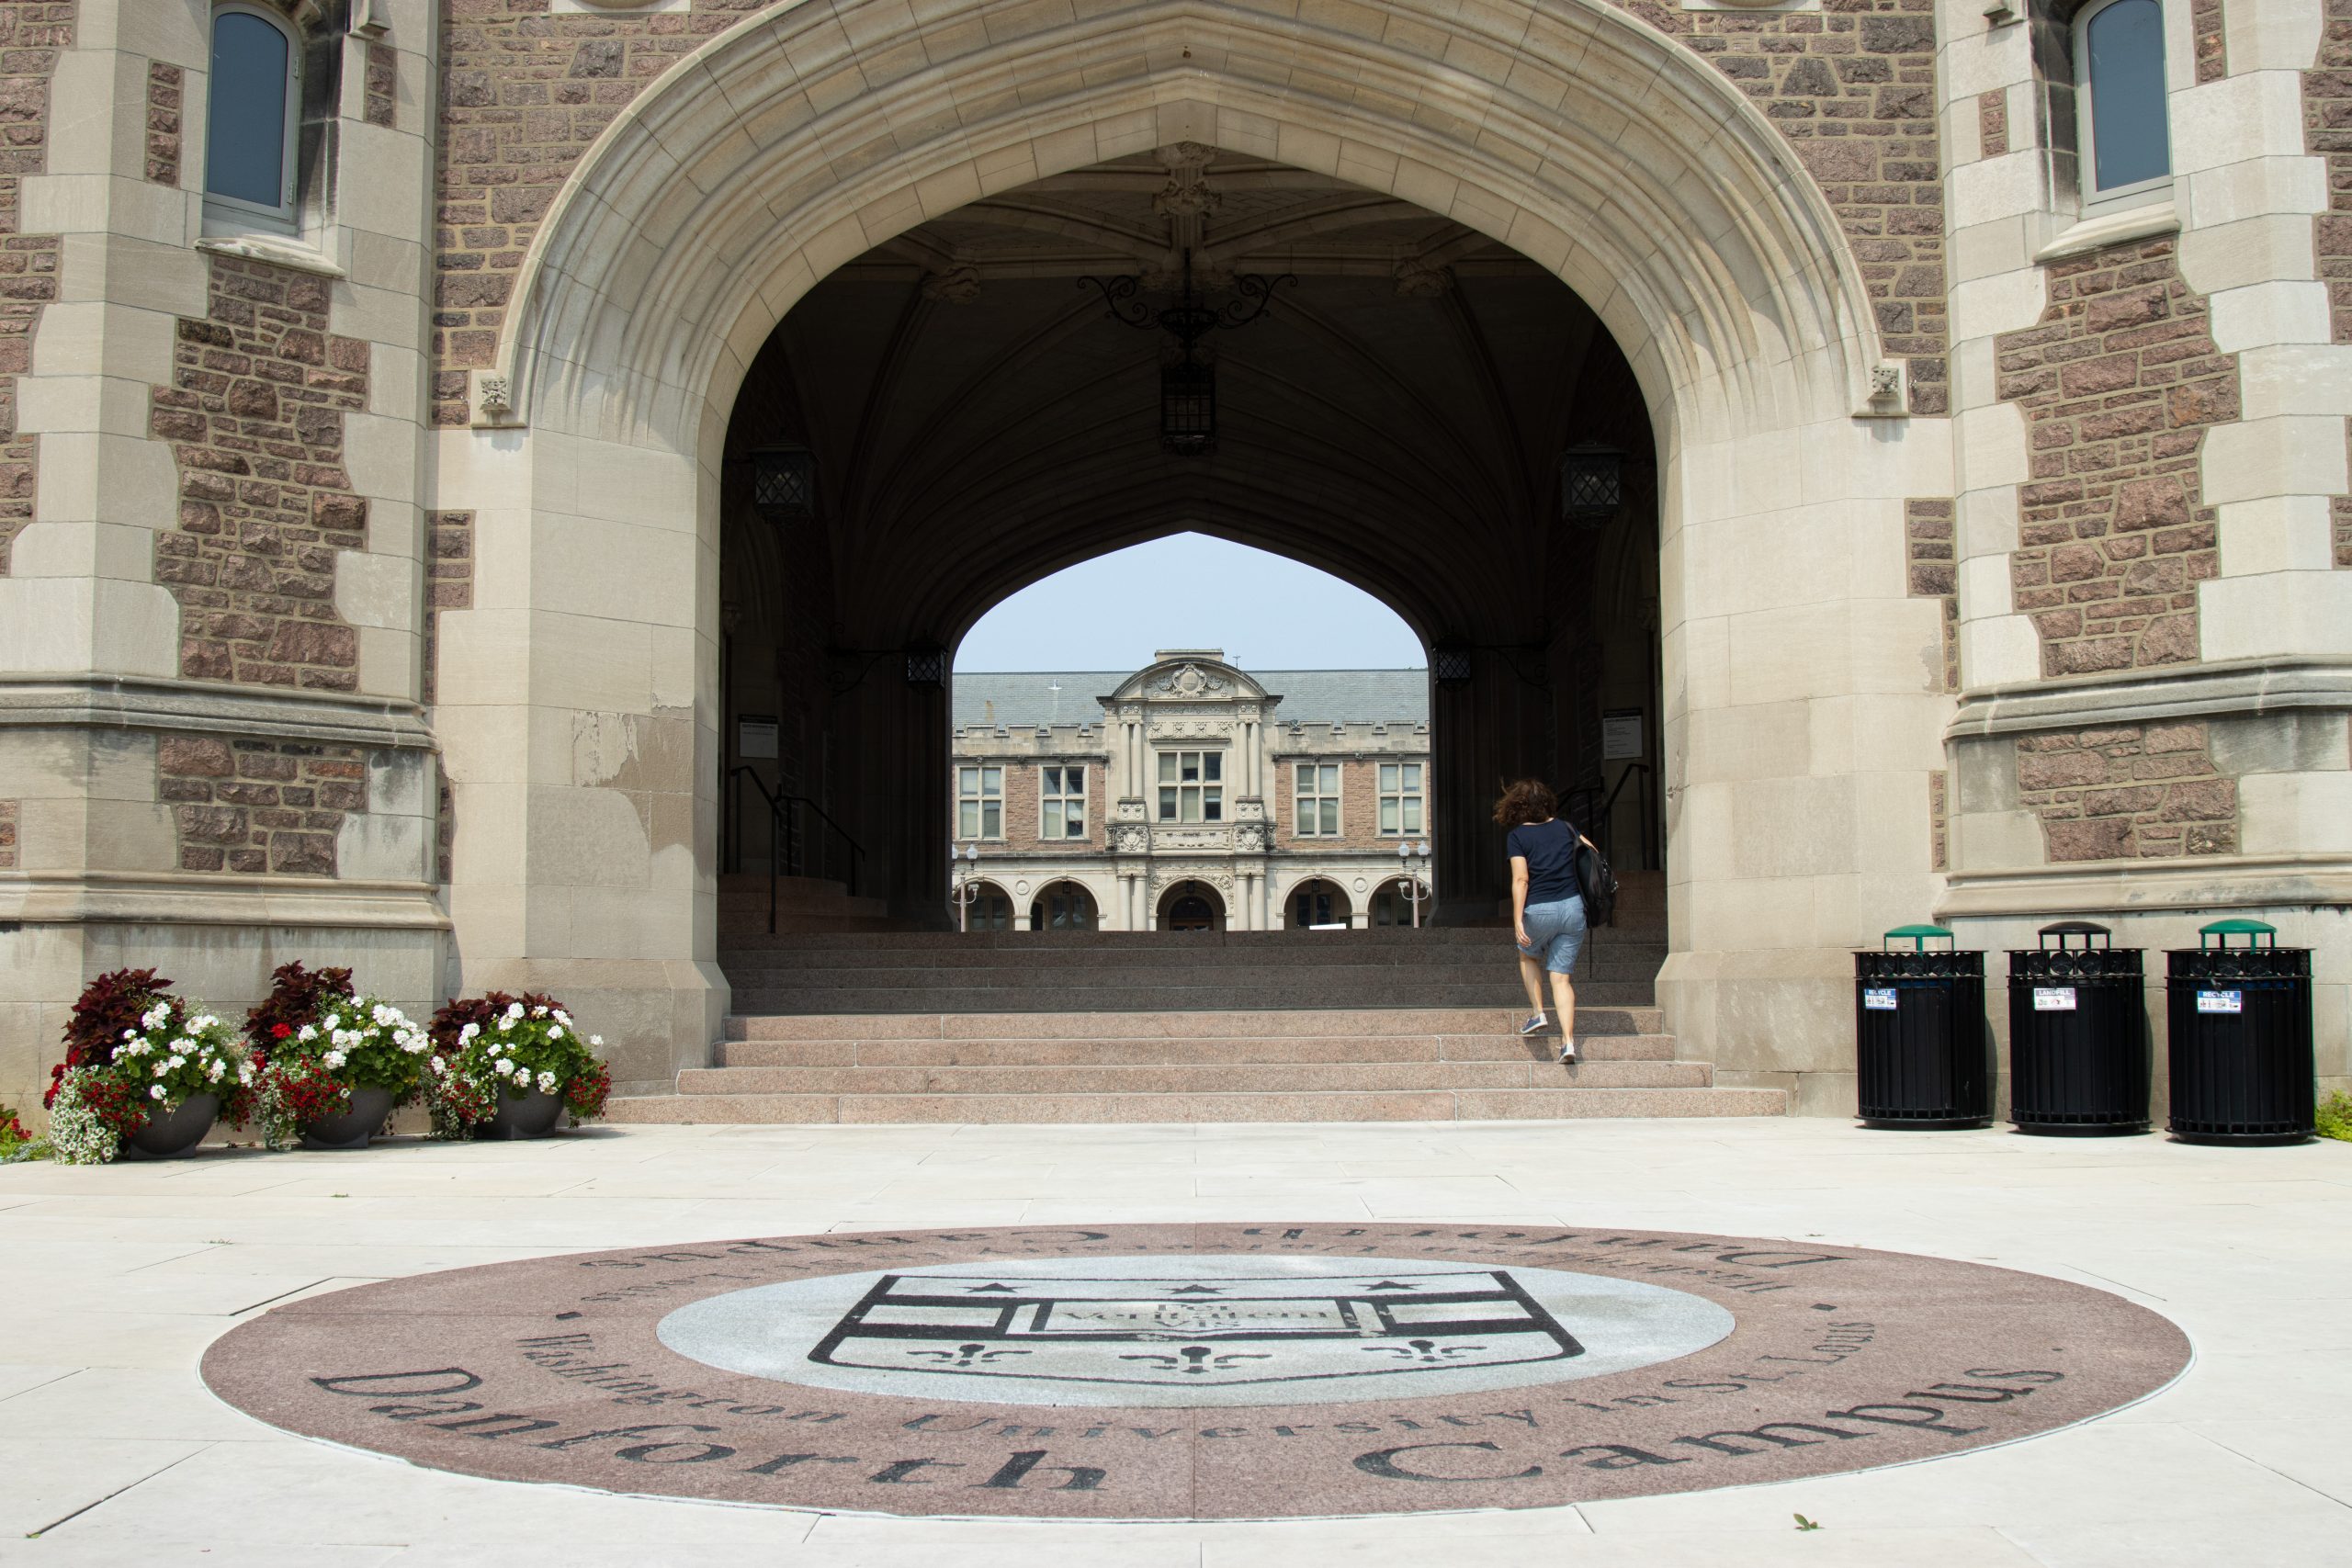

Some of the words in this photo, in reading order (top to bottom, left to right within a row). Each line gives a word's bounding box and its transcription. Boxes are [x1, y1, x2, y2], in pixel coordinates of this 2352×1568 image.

[579, 1231, 1109, 1269] Campus
[1242, 1228, 1857, 1269] Danforth
[580, 1273, 761, 1302] Louis
[1421, 1246, 1796, 1293] Washington
[1154, 1319, 1240, 1328] Vis
[515, 1333, 847, 1423] Washington
[901, 1409, 1540, 1439] University
[1563, 1392, 1683, 1412] in
[1663, 1371, 1804, 1393] St.
[1757, 1321, 1875, 1366] Louis
[310, 1367, 1108, 1491] Danforth
[1351, 1367, 2065, 1482] Campus
